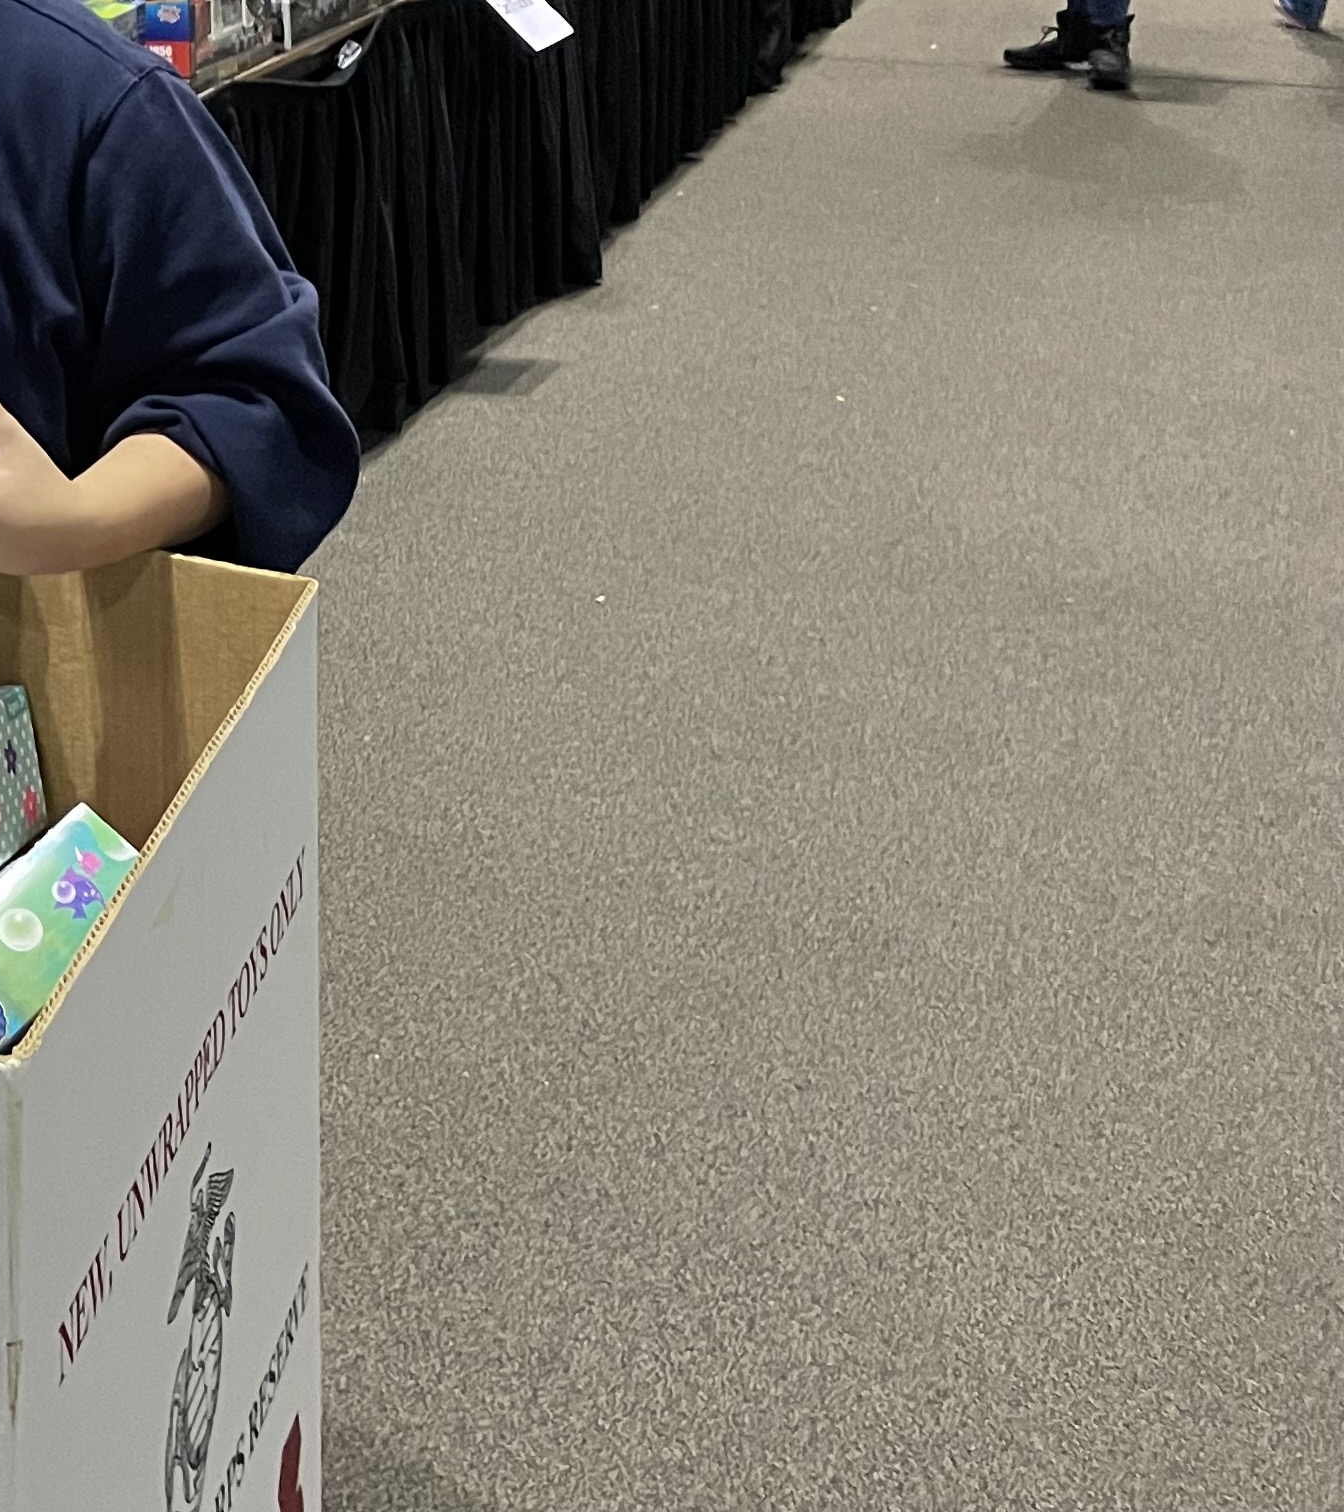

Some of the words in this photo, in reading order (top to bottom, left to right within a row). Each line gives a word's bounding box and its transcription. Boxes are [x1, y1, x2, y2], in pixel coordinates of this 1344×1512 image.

[116, 1008, 226, 1262] UNWRAPPED
[227, 924, 270, 1041] TOYS
[268, 843, 307, 957] ONLY
